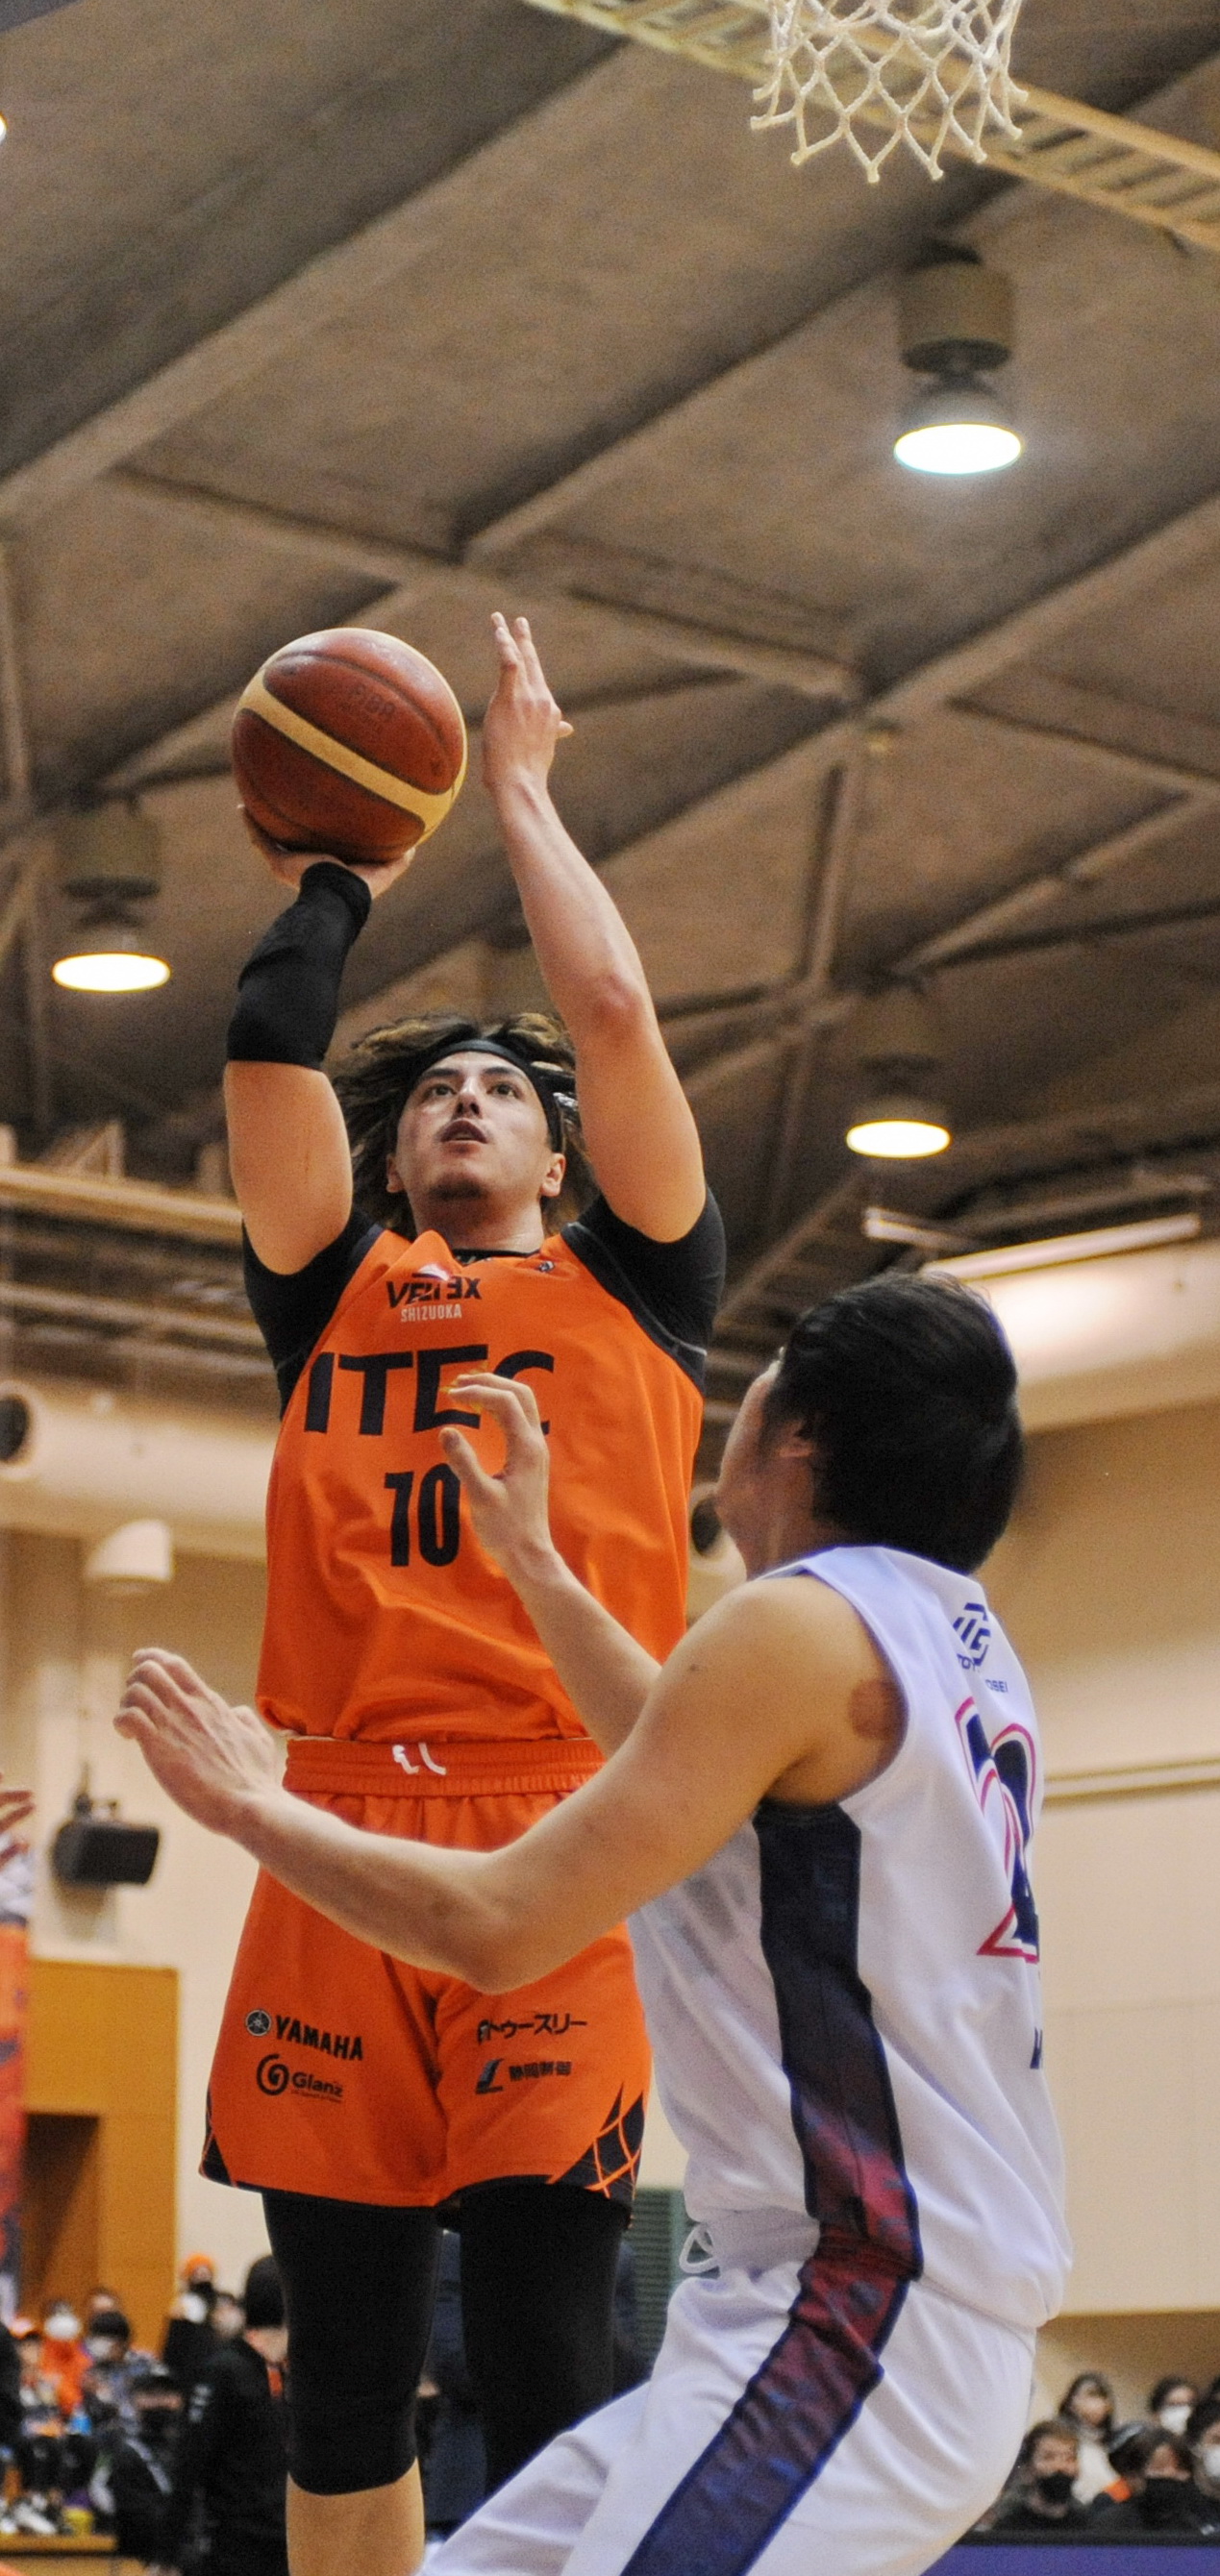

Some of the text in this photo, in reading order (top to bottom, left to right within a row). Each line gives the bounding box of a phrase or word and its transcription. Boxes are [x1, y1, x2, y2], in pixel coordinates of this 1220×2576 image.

[401, 1303, 462, 1323] SHIZUOKA
[385, 1463, 461, 1568] 10
[275, 2015, 363, 2061] YAMAHA
[292, 2071, 343, 2097] Glanz
